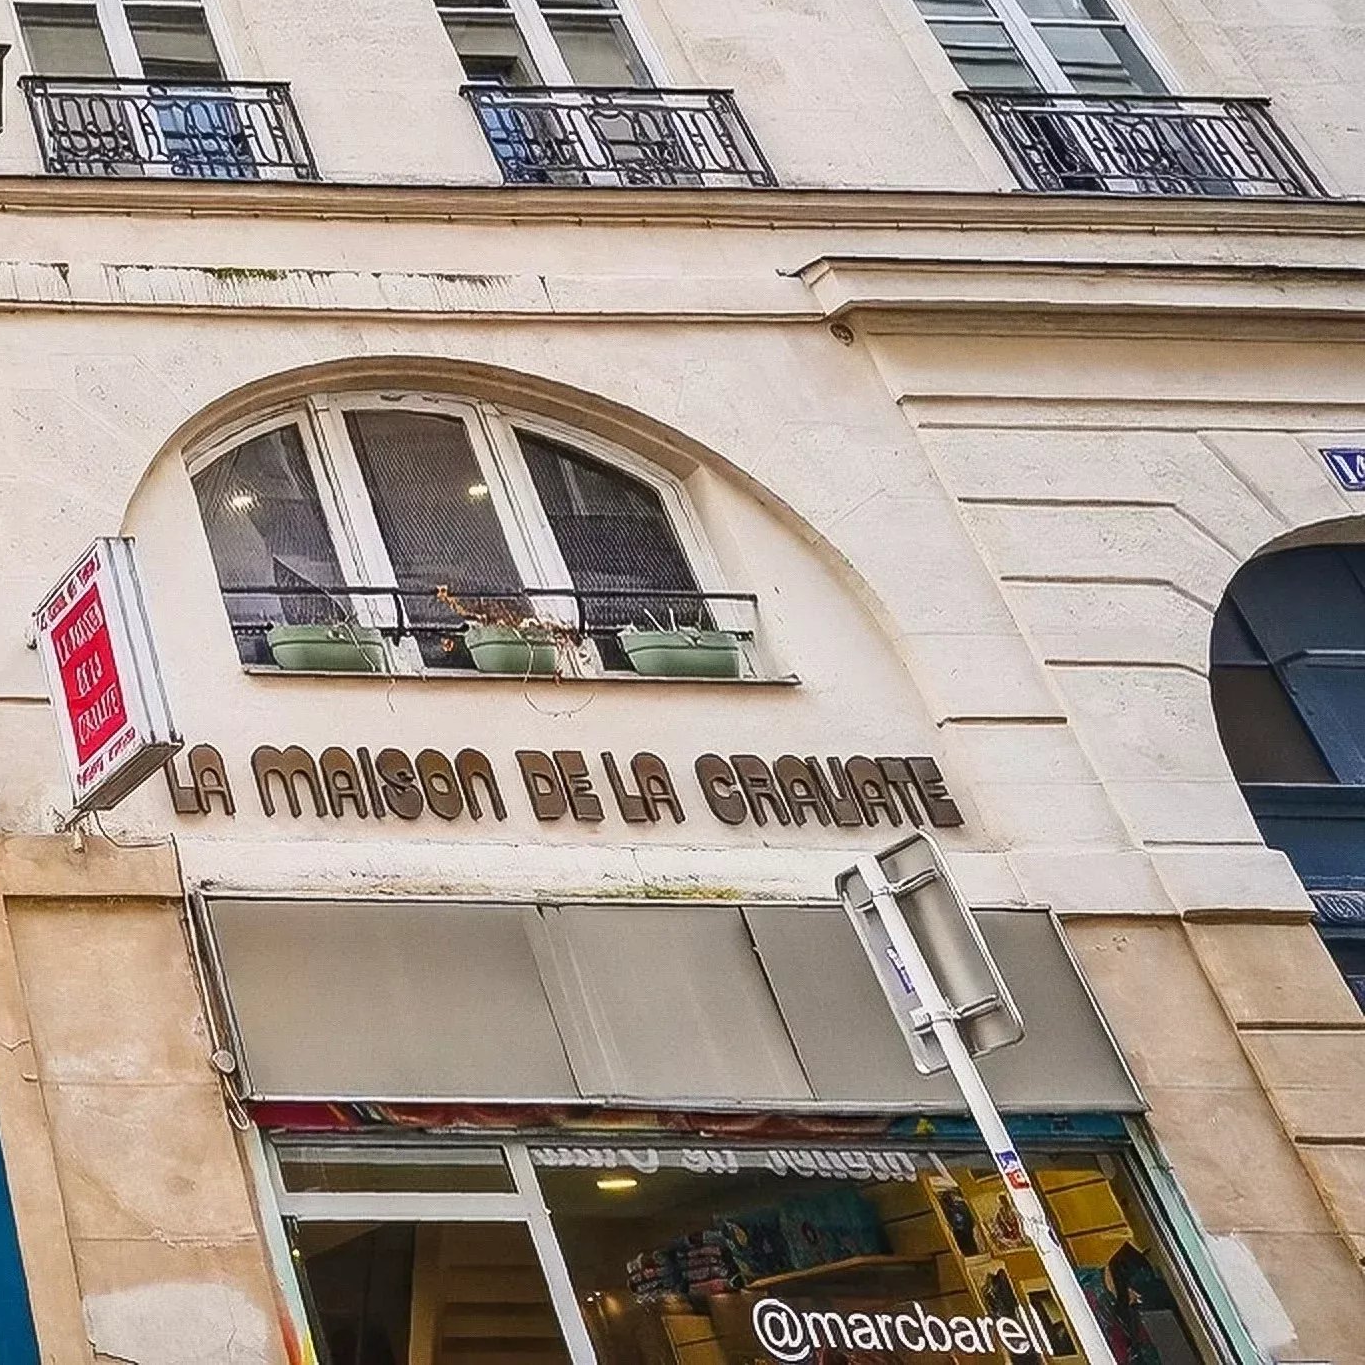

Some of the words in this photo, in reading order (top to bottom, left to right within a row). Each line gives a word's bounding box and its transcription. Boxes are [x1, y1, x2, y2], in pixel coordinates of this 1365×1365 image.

[165, 743, 236, 816] LA
[251, 744, 508, 822] MAISON
[514, 749, 605, 822] DE
[600, 751, 686, 825] LA
[694, 752, 966, 829] CRAVATE
[752, 1297, 1055, 1362] @marcbarell
